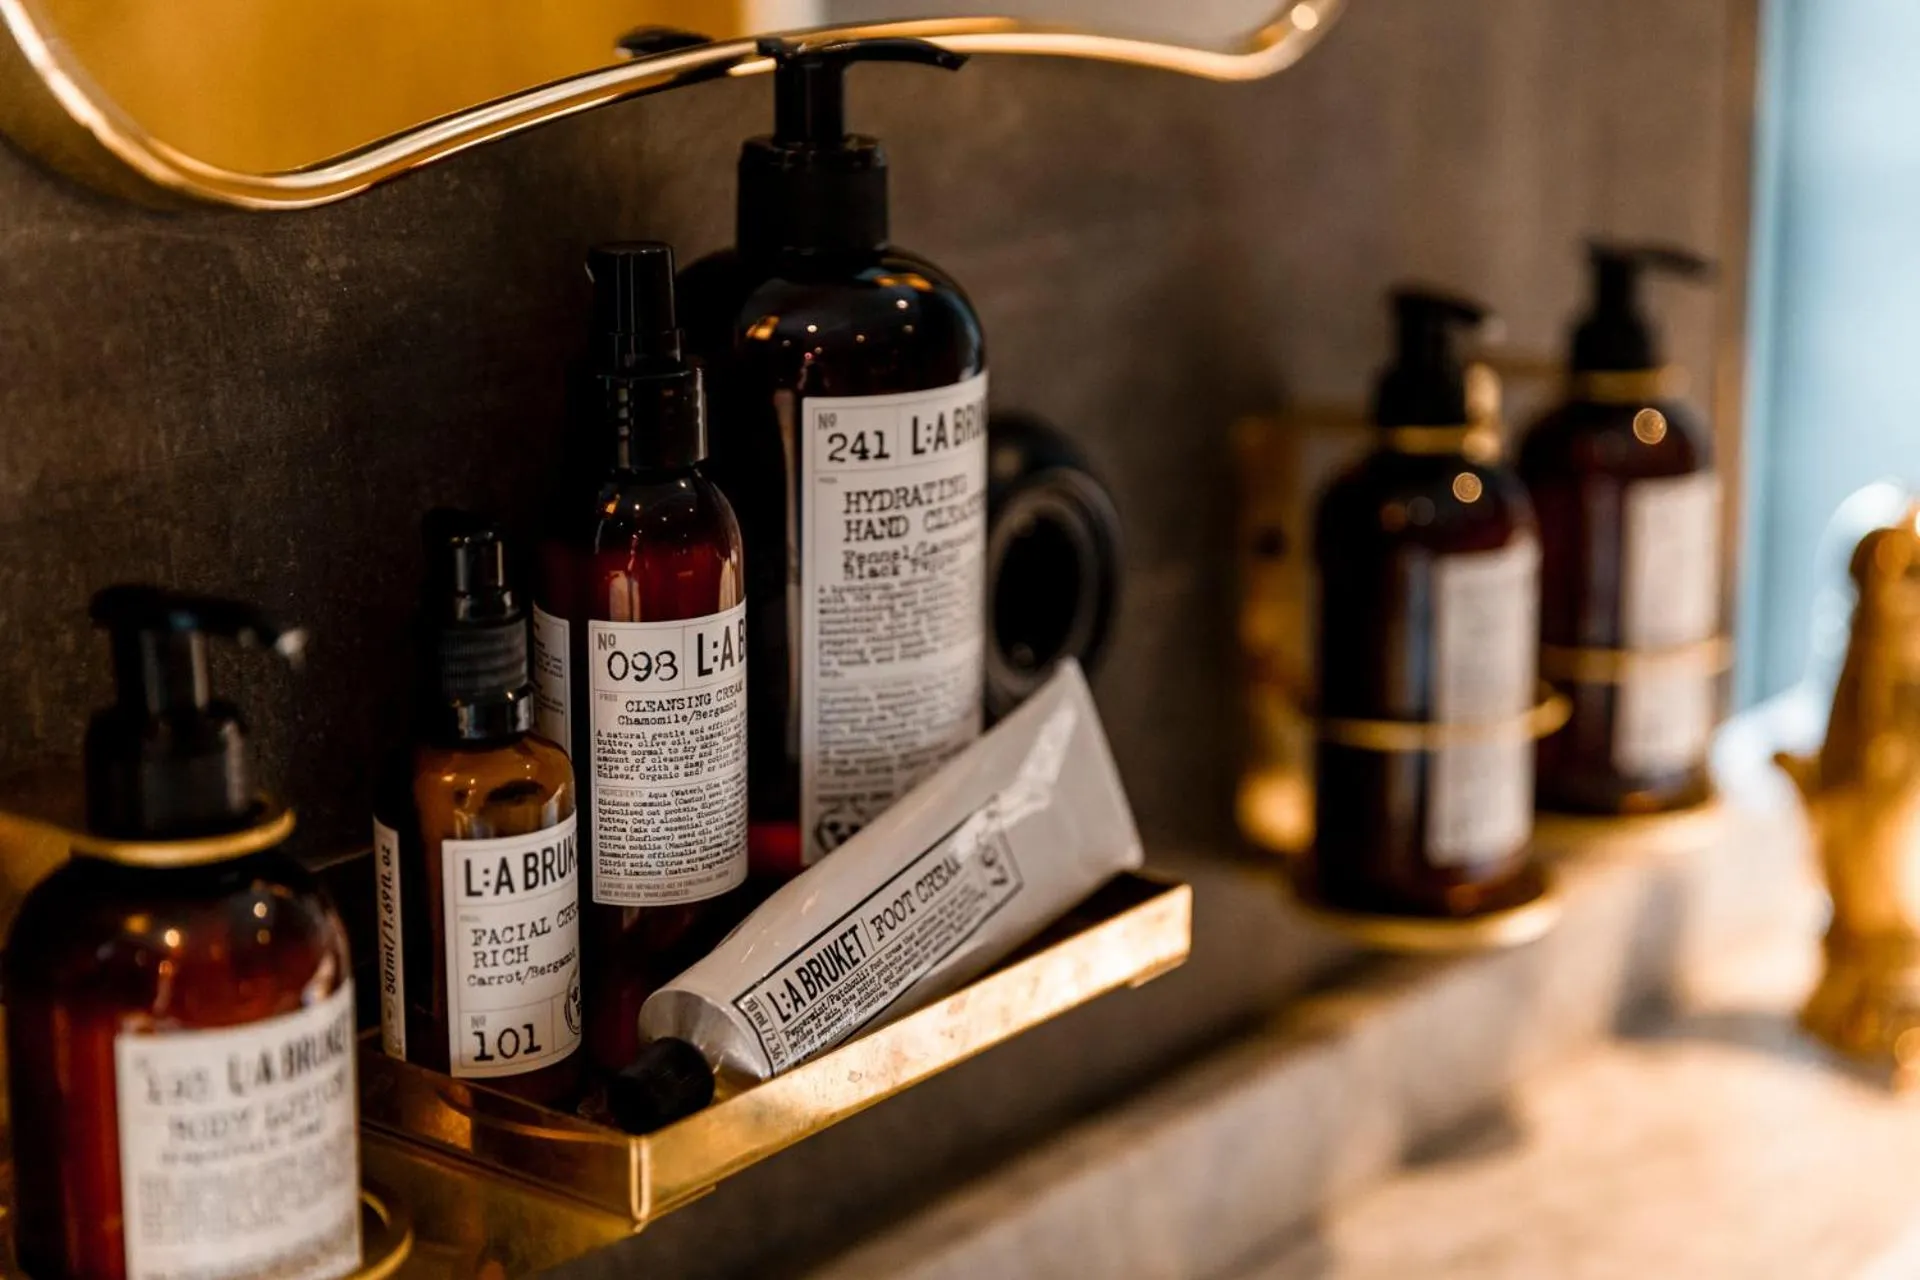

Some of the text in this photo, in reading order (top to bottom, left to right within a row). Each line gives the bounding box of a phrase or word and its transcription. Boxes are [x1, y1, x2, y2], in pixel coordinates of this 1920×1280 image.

[912, 411, 949, 456] L:A
[827, 430, 890, 462] 241
[843, 473, 968, 514] HYDRATING
[843, 515, 910, 542] HAND
[843, 560, 900, 581] Black
[697, 625, 735, 678] L:A
[607, 650, 678, 682] 098
[617, 700, 737, 726] Chamomile/Bergamot
[625, 692, 712, 713] CLEANSING
[597, 730, 603, 738] A
[606, 732, 646, 740] natural
[651, 730, 685, 741] gentle
[689, 727, 705, 735] and
[637, 739, 667, 748] olive
[597, 756, 630, 764] amount
[634, 755, 646, 764] of
[631, 746, 664, 756] normal
[668, 746, 679, 755] to
[683, 744, 697, 755] dry
[597, 764, 620, 774] wipe
[623, 764, 641, 773] off
[645, 764, 669, 773] with
[639, 771, 680, 783] Organic
[648, 791, 667, 799] Aqua
[632, 816, 656, 827] Cetyl
[651, 825, 661, 833] of
[599, 841, 627, 850] Citrus
[625, 832, 675, 843] (Sunflower)
[655, 857, 684, 868] Citrus
[464, 856, 515, 898] L:A
[870, 890, 917, 942] FOOT
[471, 916, 551, 947] FACIAL
[472, 944, 529, 969] RICH
[467, 947, 576, 988] Carrot/Bergamot
[766, 924, 867, 1024] L:A BRUKET
[753, 1011, 769, 1030] ml
[473, 1023, 542, 1063] 101
